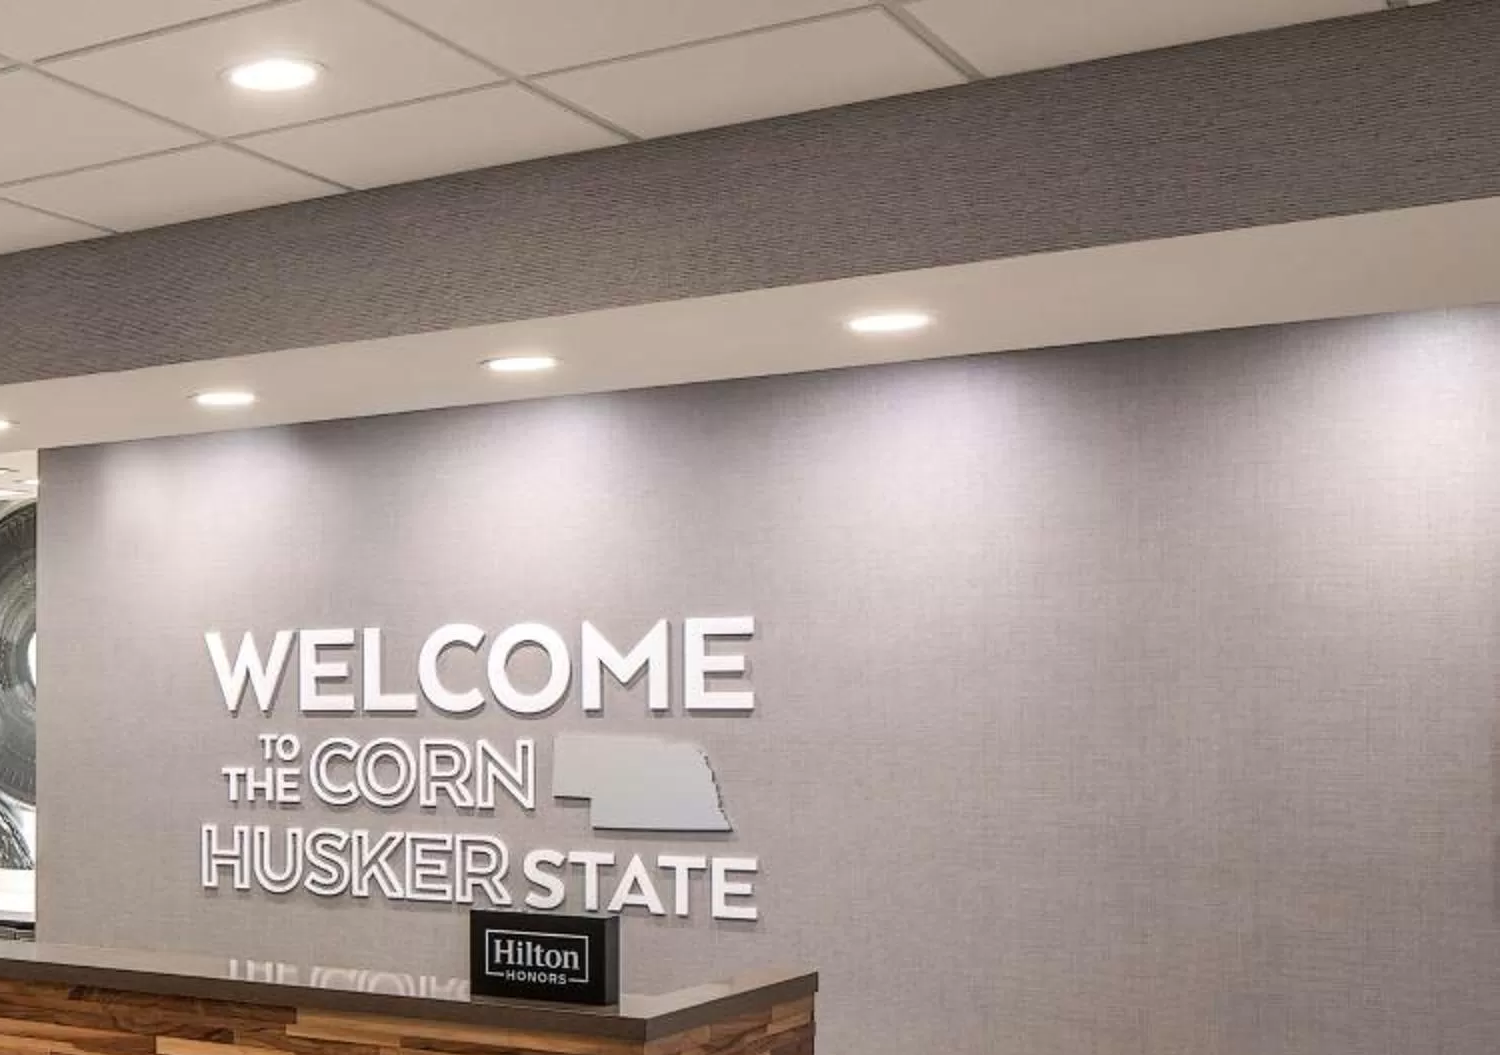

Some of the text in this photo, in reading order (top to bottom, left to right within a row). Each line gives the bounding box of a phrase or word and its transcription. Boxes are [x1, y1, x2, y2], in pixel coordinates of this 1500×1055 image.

[204, 616, 755, 714] WELCOME
[259, 733, 301, 761] TO
[222, 737, 536, 810] THE CORN
[202, 824, 759, 920] HUSKER STATE
[493, 939, 580, 970] Hilton
[505, 970, 567, 985] HONORS
